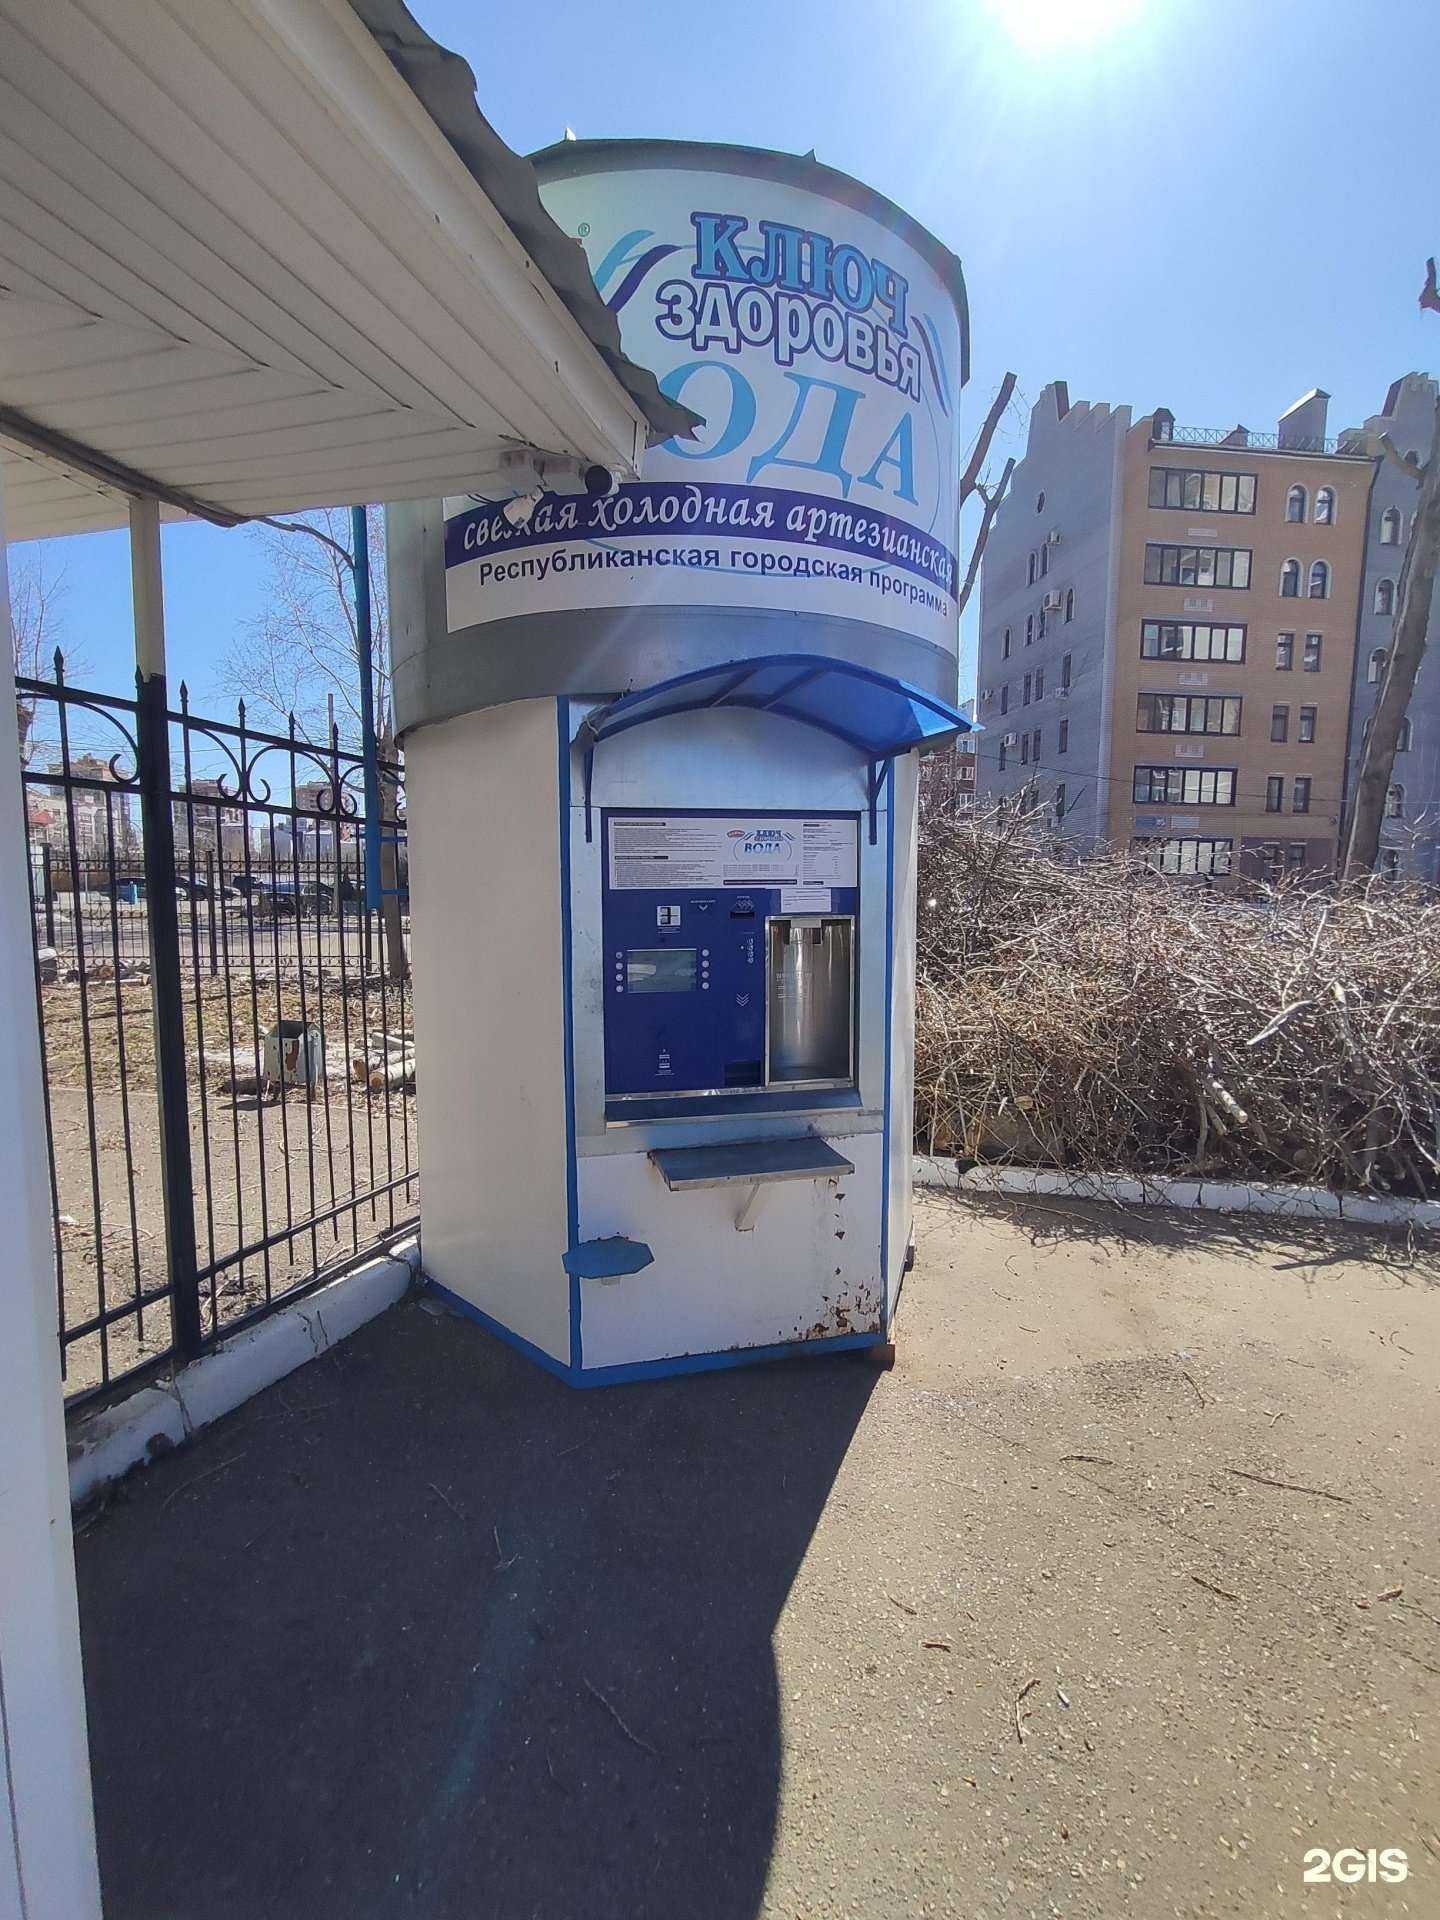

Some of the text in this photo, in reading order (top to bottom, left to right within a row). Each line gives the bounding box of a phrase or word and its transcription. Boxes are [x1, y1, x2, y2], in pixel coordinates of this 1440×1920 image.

[691, 211, 909, 338] КЛЮЧ
[657, 360, 919, 506] ОДА
[479, 549, 948, 617] Республиканская городская программа
[588, 485, 775, 532] холодная
[786, 503, 953, 585] артезианская
